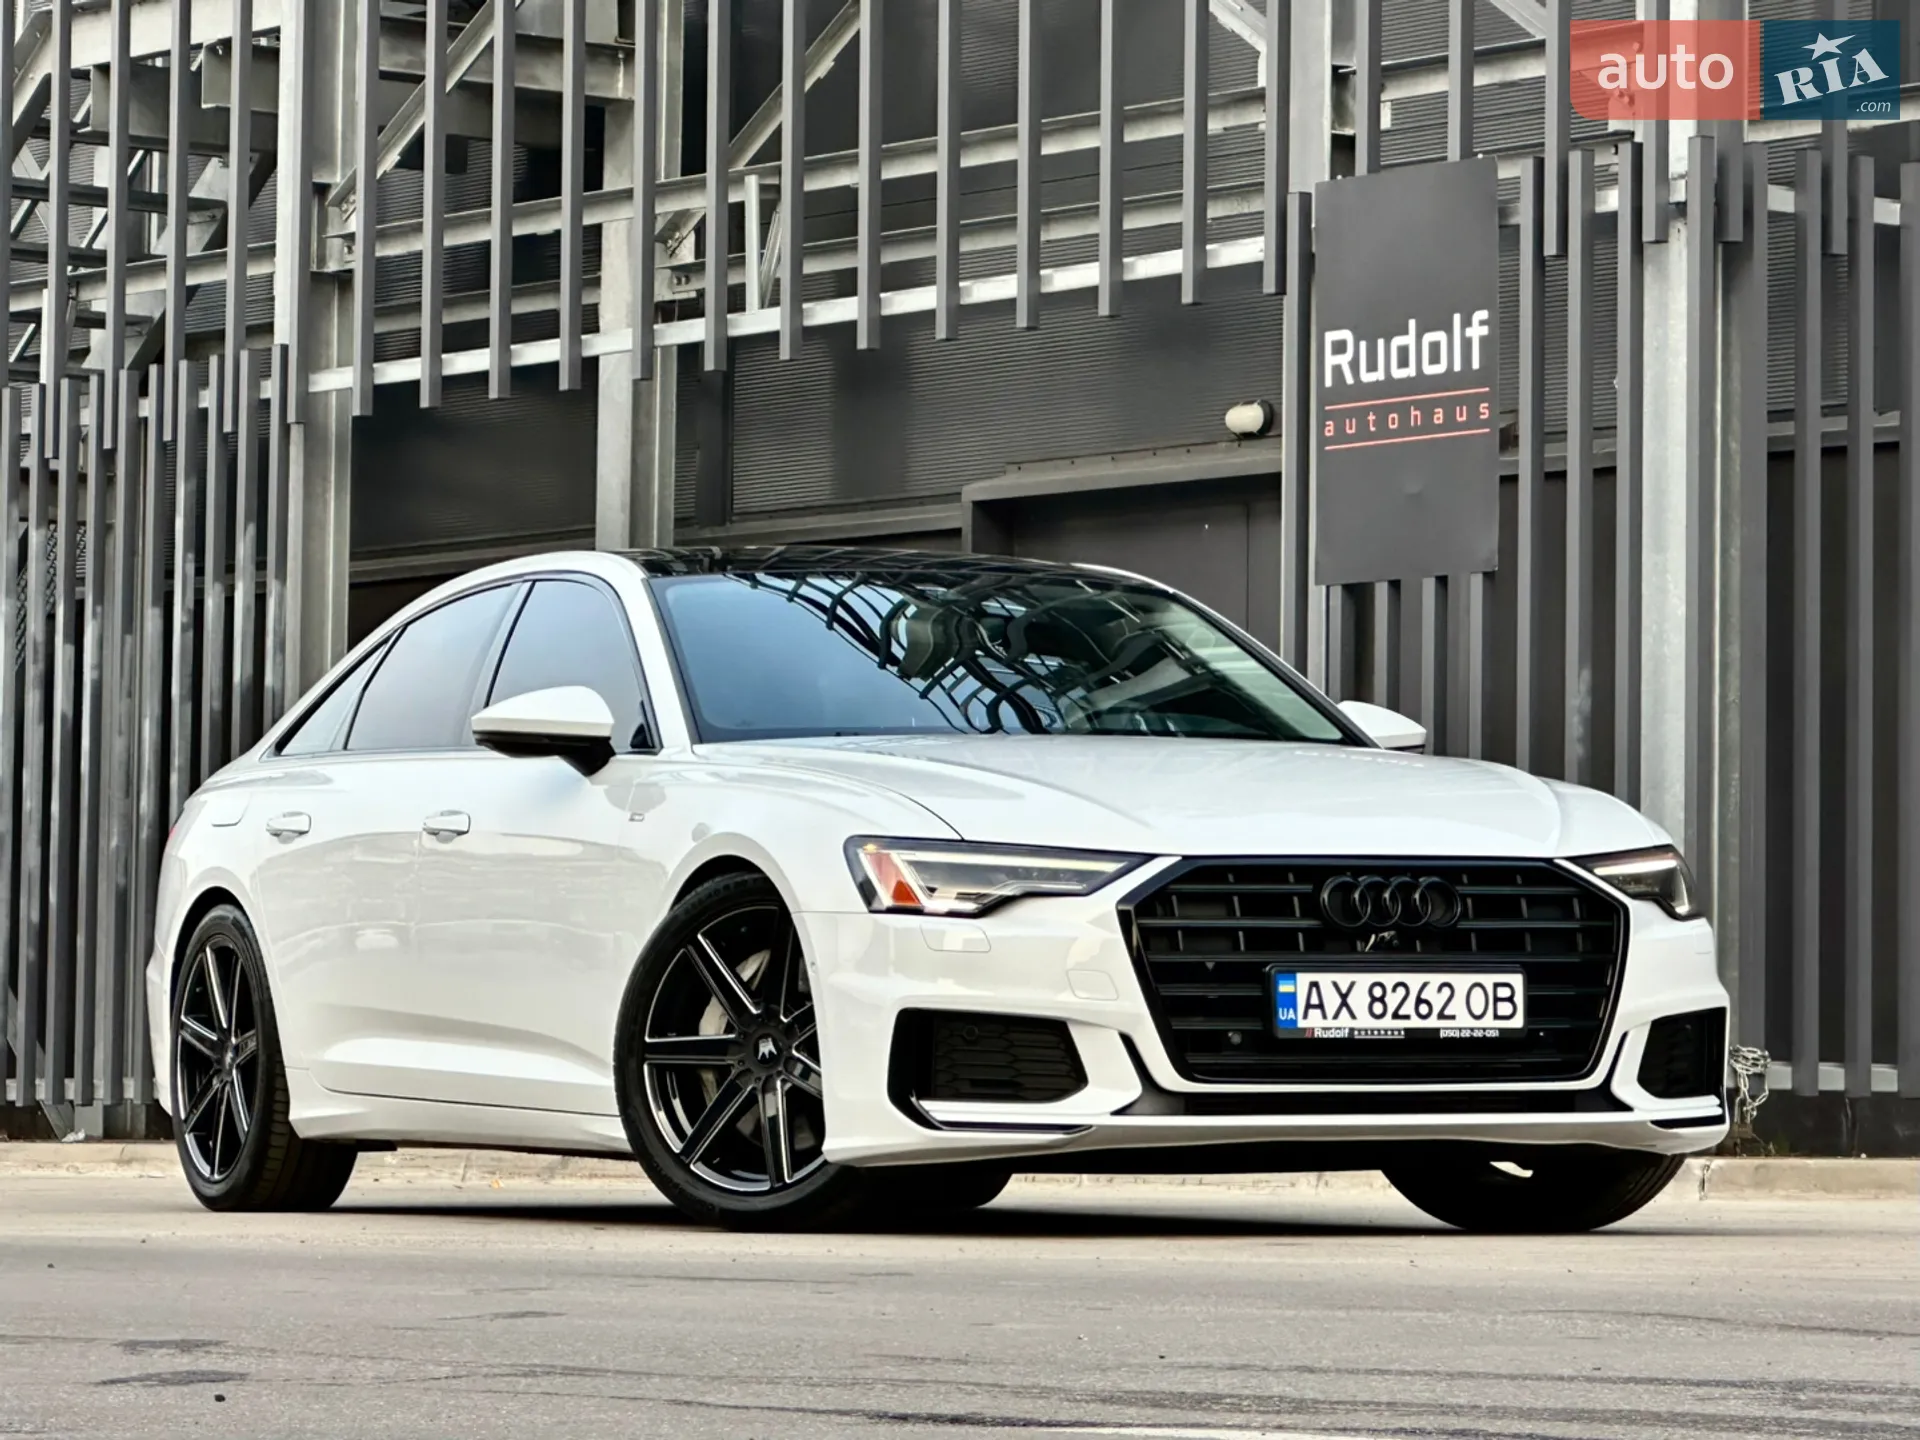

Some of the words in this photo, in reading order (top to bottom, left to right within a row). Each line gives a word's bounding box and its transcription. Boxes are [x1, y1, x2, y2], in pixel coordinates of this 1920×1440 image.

[1324, 309, 1489, 388] Rudolf
[1324, 402, 1490, 436] autohaus
[1278, 1009, 1296, 1020] UA
[1302, 981, 1357, 1020] AX
[1367, 981, 1456, 1020] 8262
[1465, 981, 1518, 1020] OB
